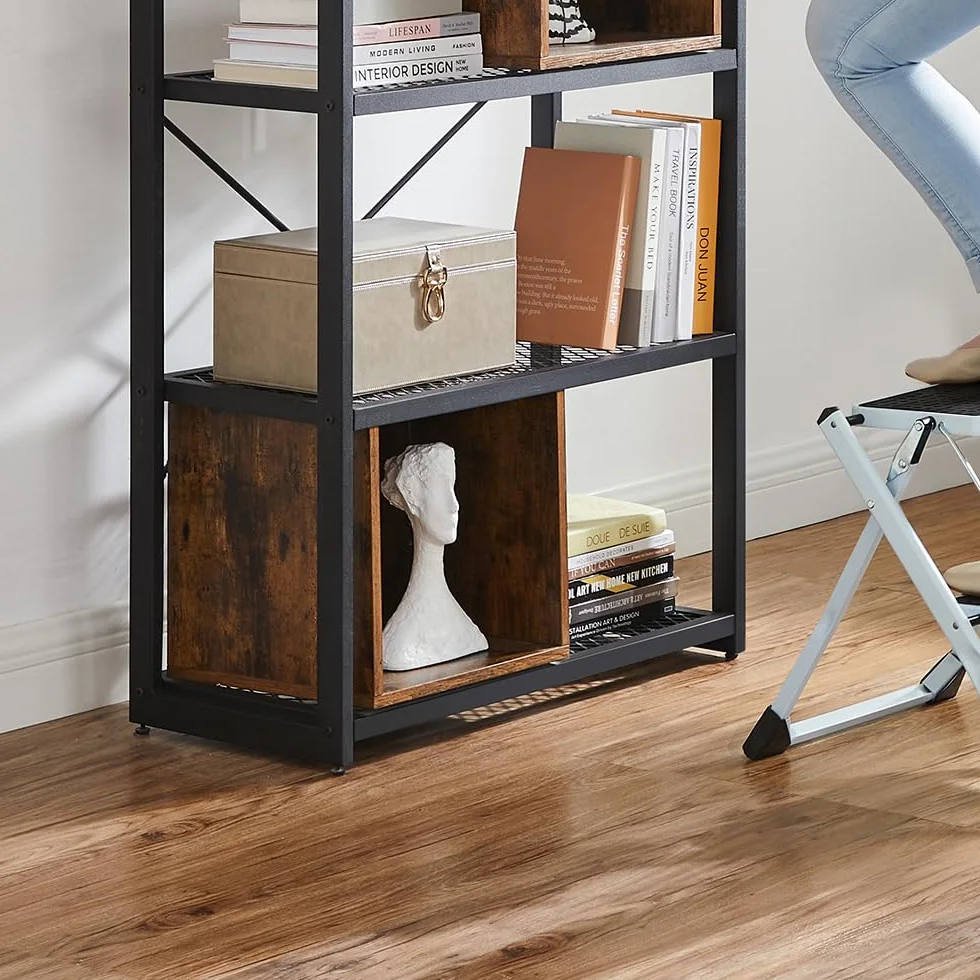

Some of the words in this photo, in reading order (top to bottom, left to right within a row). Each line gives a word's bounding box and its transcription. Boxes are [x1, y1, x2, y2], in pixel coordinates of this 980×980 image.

[389, 24, 432, 37] LIFESPAN
[369, 49, 405, 58] MODERN
[408, 44, 436, 54] LIVING
[355, 65, 409, 82] INTERIOR
[412, 60, 454, 76] DESIGN
[671, 150, 681, 186] TRAVEL
[652, 164, 661, 200] MAKE
[686, 147, 698, 230] INSPIRATIONS
[668, 189, 679, 218] BOOK
[619, 224, 630, 247] The
[648, 206, 658, 241] YOUR
[699, 228, 710, 260] DON
[614, 248, 626, 288] Scarlet
[646, 247, 654, 271] BED
[697, 264, 708, 302] JUAN
[586, 531, 611, 547] DOUE
[619, 526, 630, 539] DE
[632, 521, 650, 535] SUIE
[606, 545, 634, 557] DECORATES
[570, 569, 578, 577] IF
[580, 562, 597, 575] YOU
[598, 557, 616, 569] CAN
[576, 583, 590, 597] ART
[591, 580, 605, 593] NEW
[606, 574, 625, 588] HOME
[626, 570, 640, 583] NEW
[641, 562, 669, 579] KITCHEN
[569, 620, 602, 635] STALLATION
[602, 618, 613, 626] ART
[619, 611, 640, 622] DESIGN
